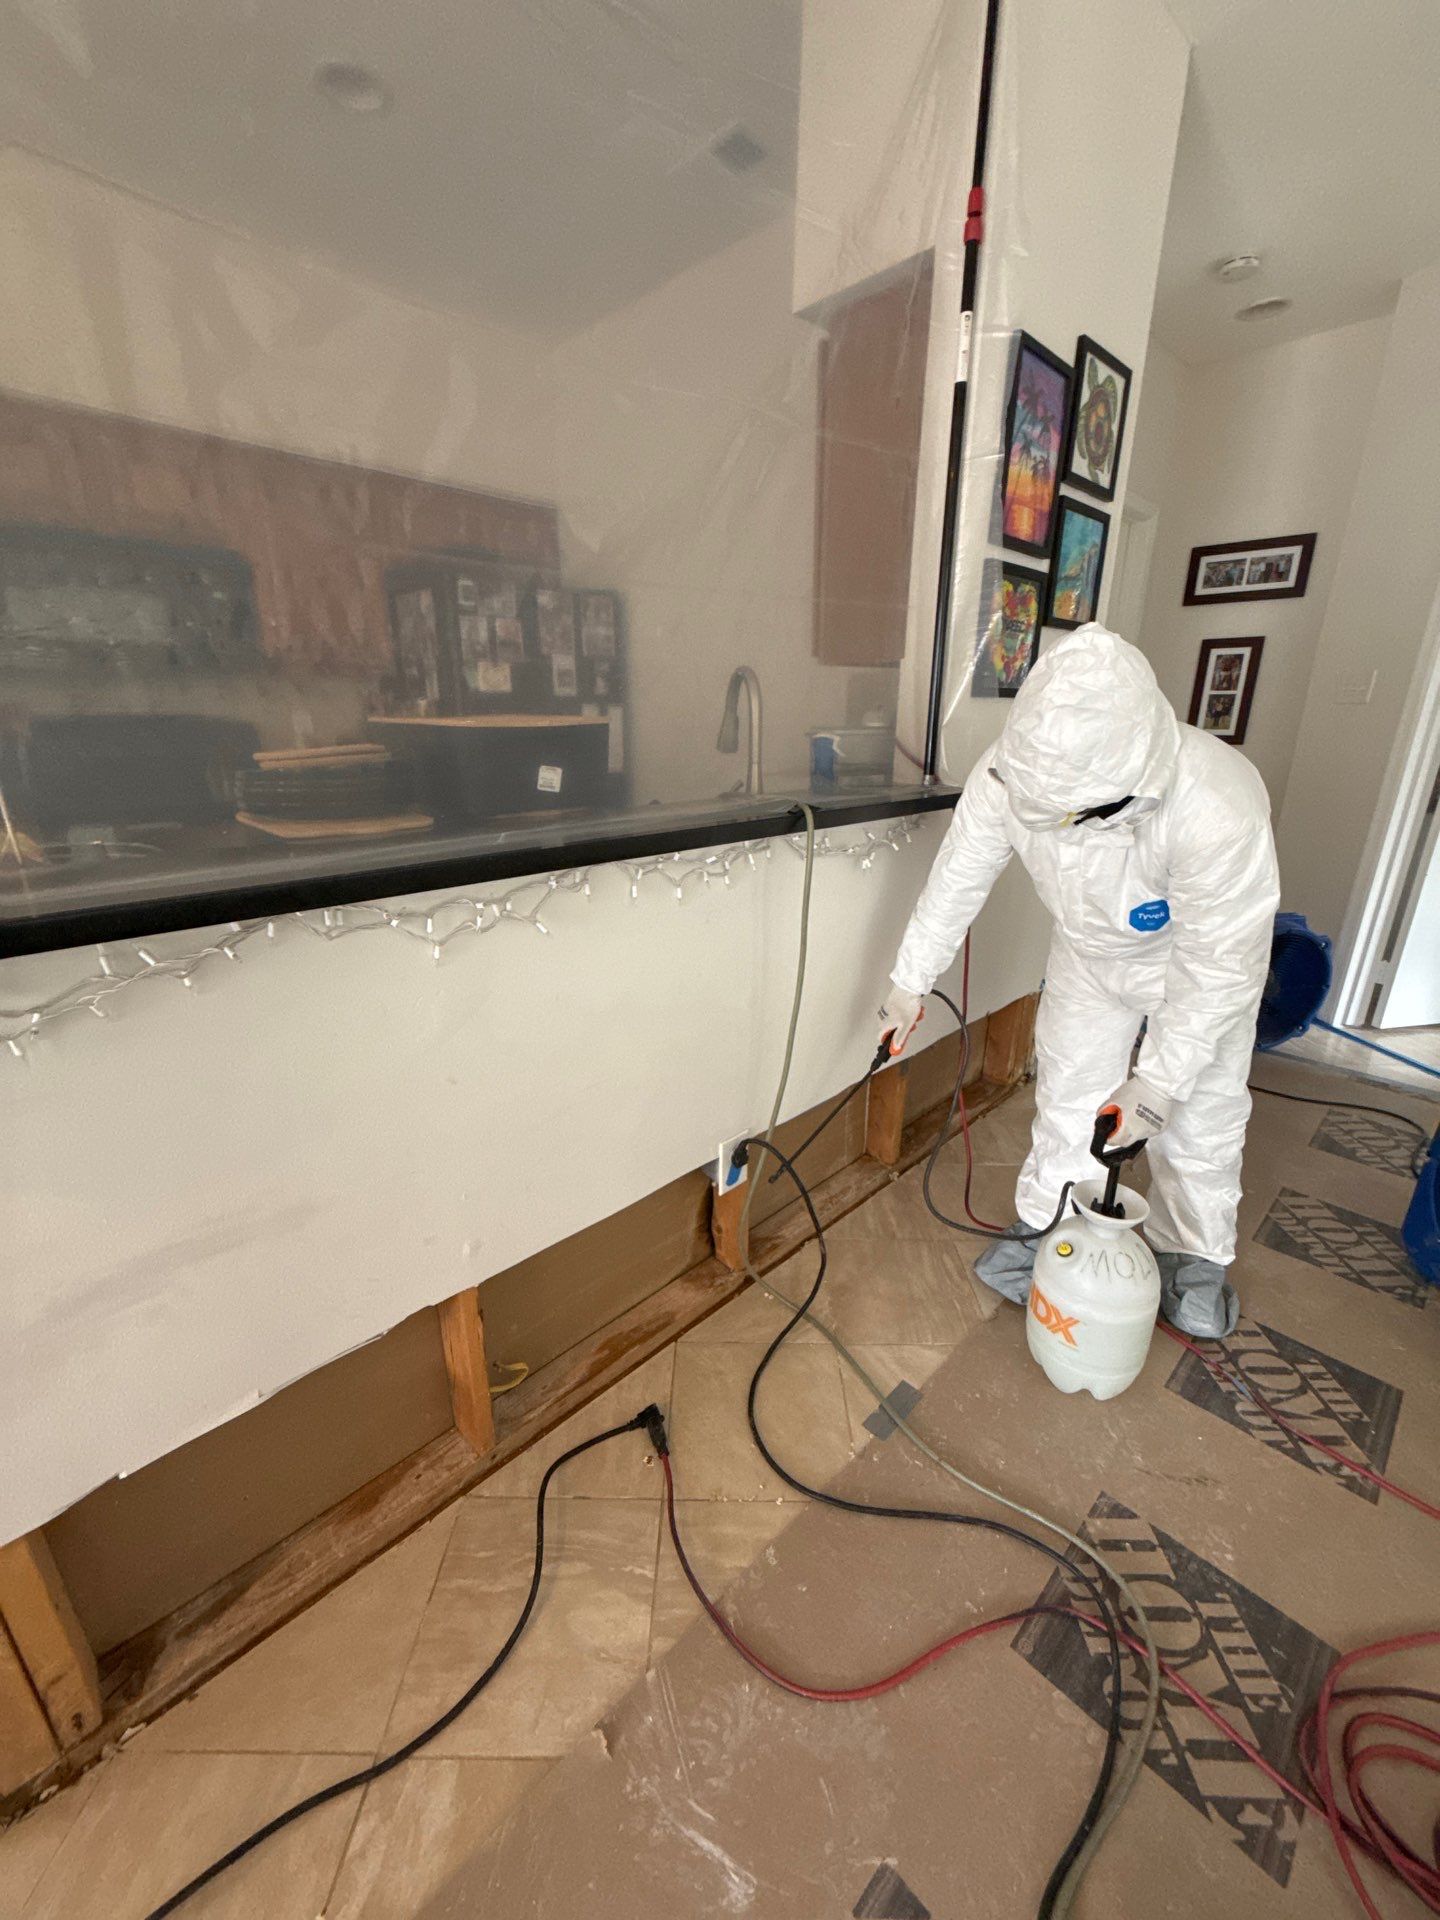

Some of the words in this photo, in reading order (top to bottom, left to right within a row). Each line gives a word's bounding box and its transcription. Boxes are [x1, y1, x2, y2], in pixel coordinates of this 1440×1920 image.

[1294, 1358, 1371, 1422] THE
[1083, 1515, 1301, 1844] HOME
[1192, 1592, 1293, 1713] THE
